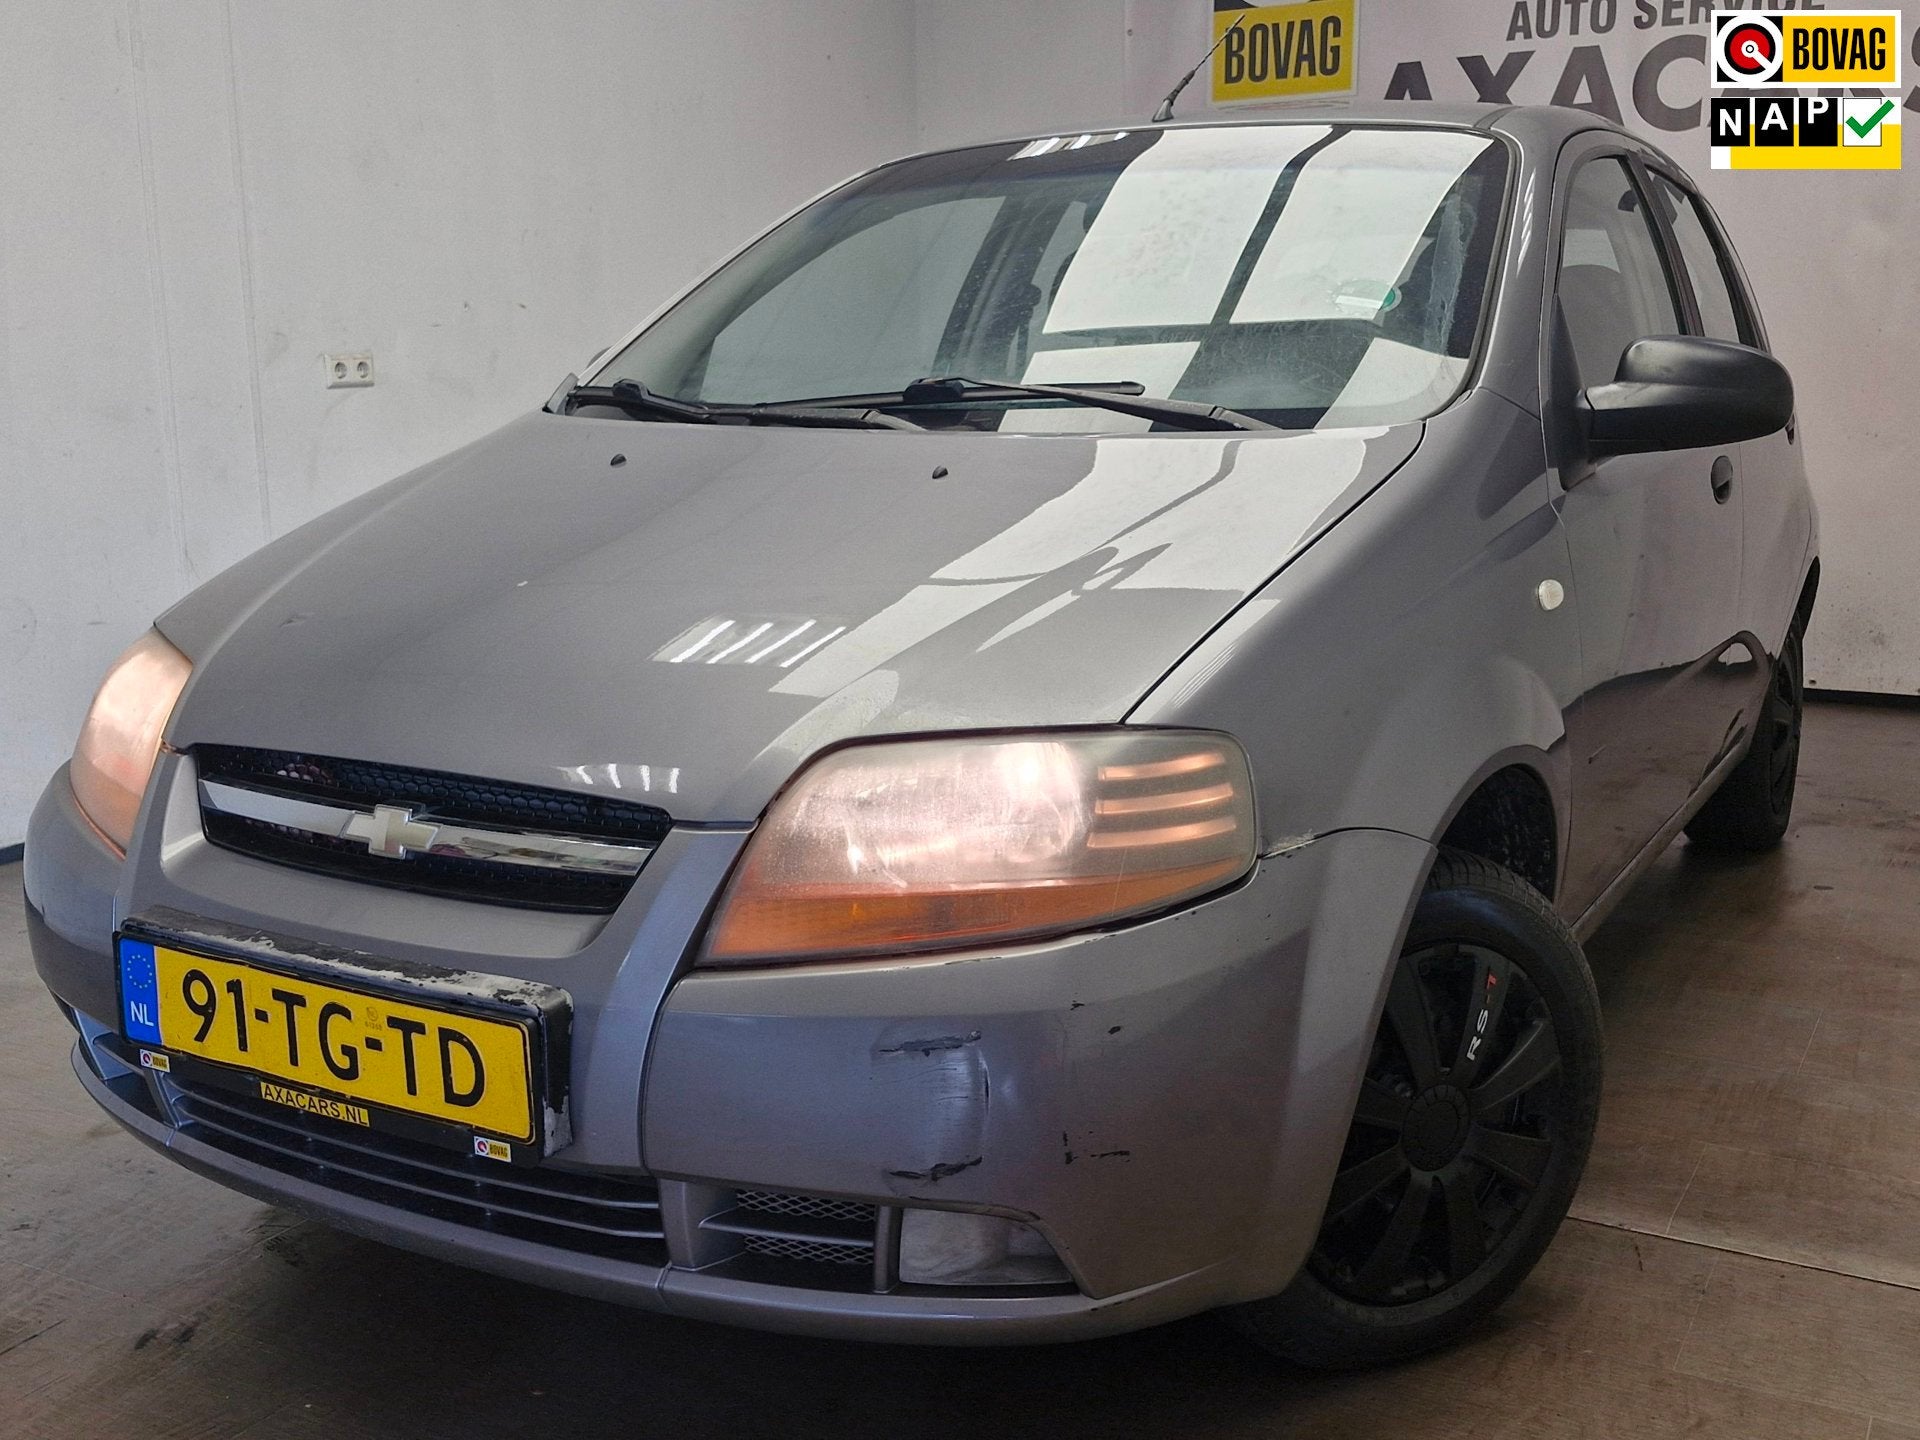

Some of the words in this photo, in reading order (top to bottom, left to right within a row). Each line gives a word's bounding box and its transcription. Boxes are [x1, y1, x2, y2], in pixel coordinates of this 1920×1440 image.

[1506, 0, 1617, 41] AUTO
[1224, 15, 1342, 84] BOVAG
[1384, 30, 1920, 132] AXAC
[130, 1000, 155, 1027] NL
[182, 968, 486, 1108] 91-TG-TD
[264, 1084, 368, 1125] AXACARS.NL
